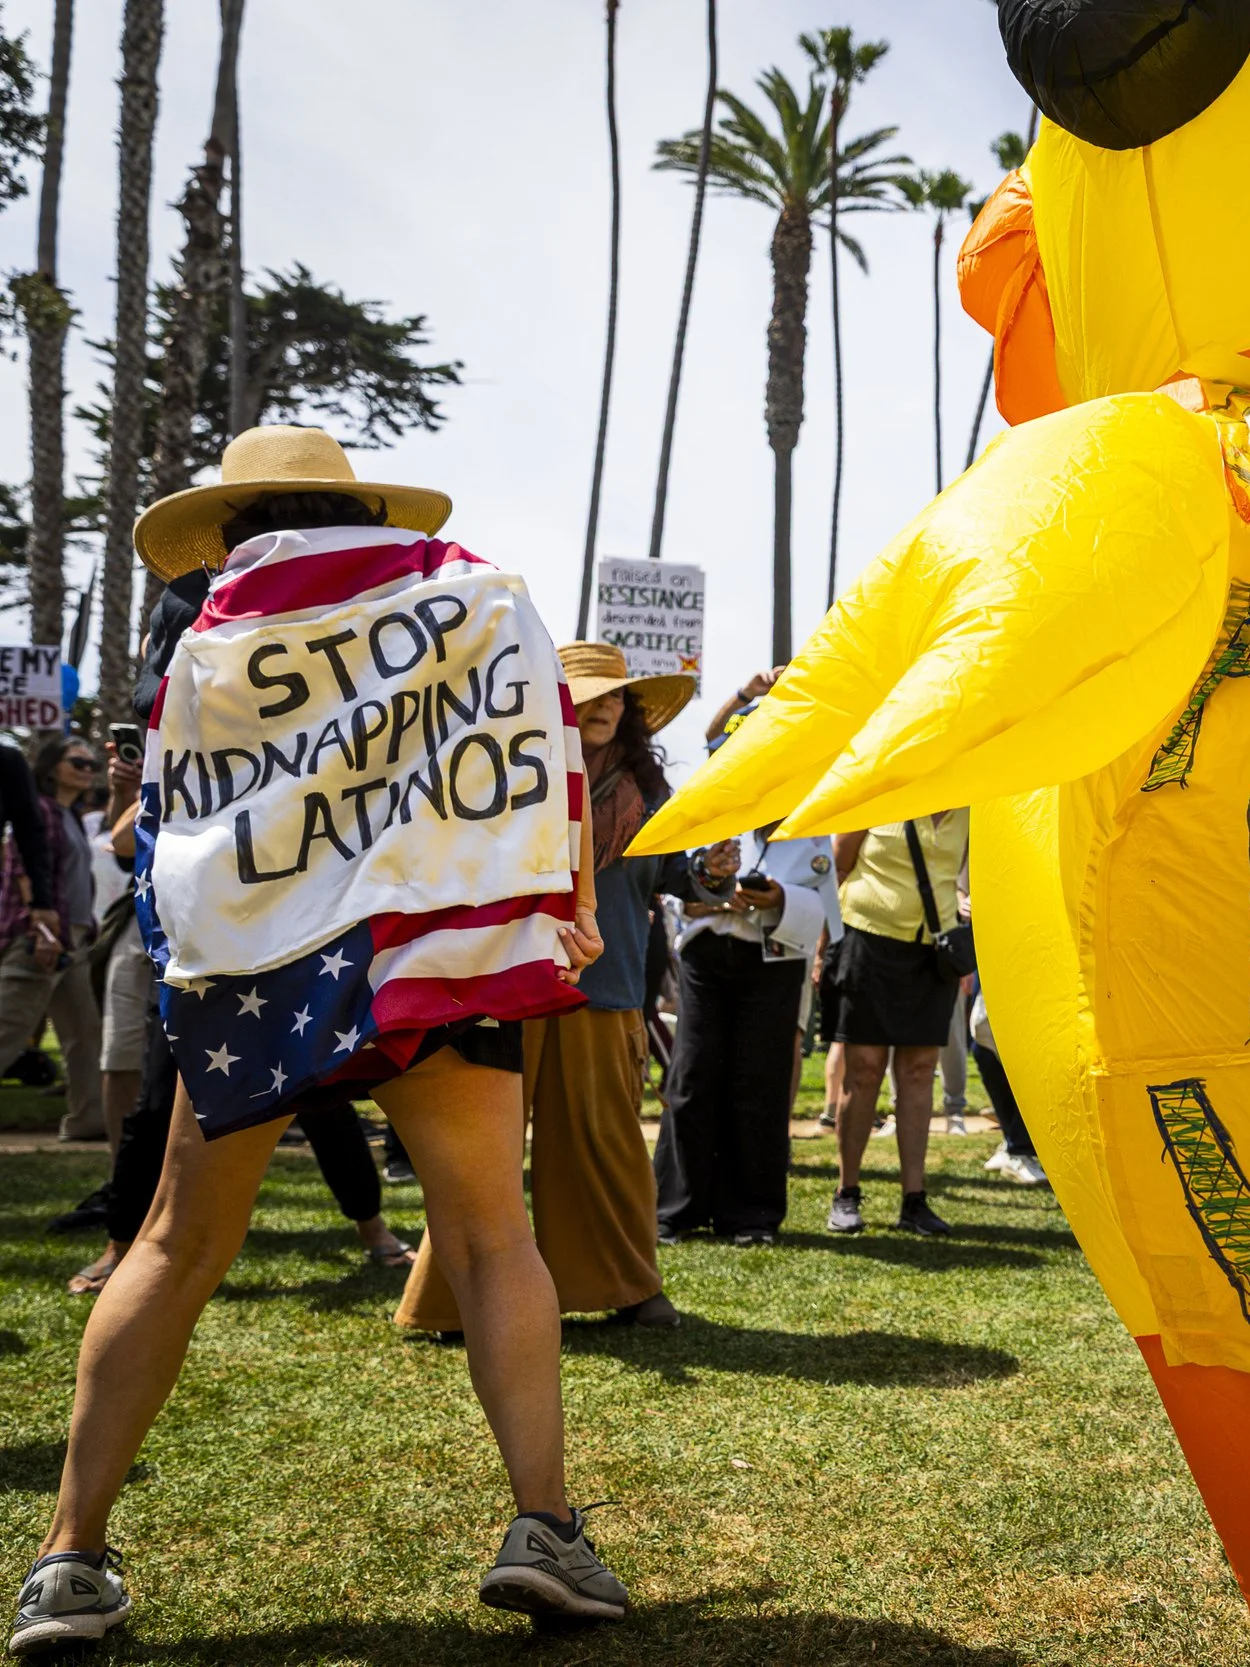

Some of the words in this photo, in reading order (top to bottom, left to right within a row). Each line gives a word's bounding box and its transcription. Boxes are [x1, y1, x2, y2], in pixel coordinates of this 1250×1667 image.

[612, 567, 661, 585] raised
[669, 574, 693, 588] on
[247, 594, 468, 719] STOP
[602, 608, 667, 628] descended
[673, 613, 702, 629] from
[21, 649, 60, 676] MY
[161, 644, 530, 823] KIDNAPPING
[234, 729, 549, 884] LATINOS
